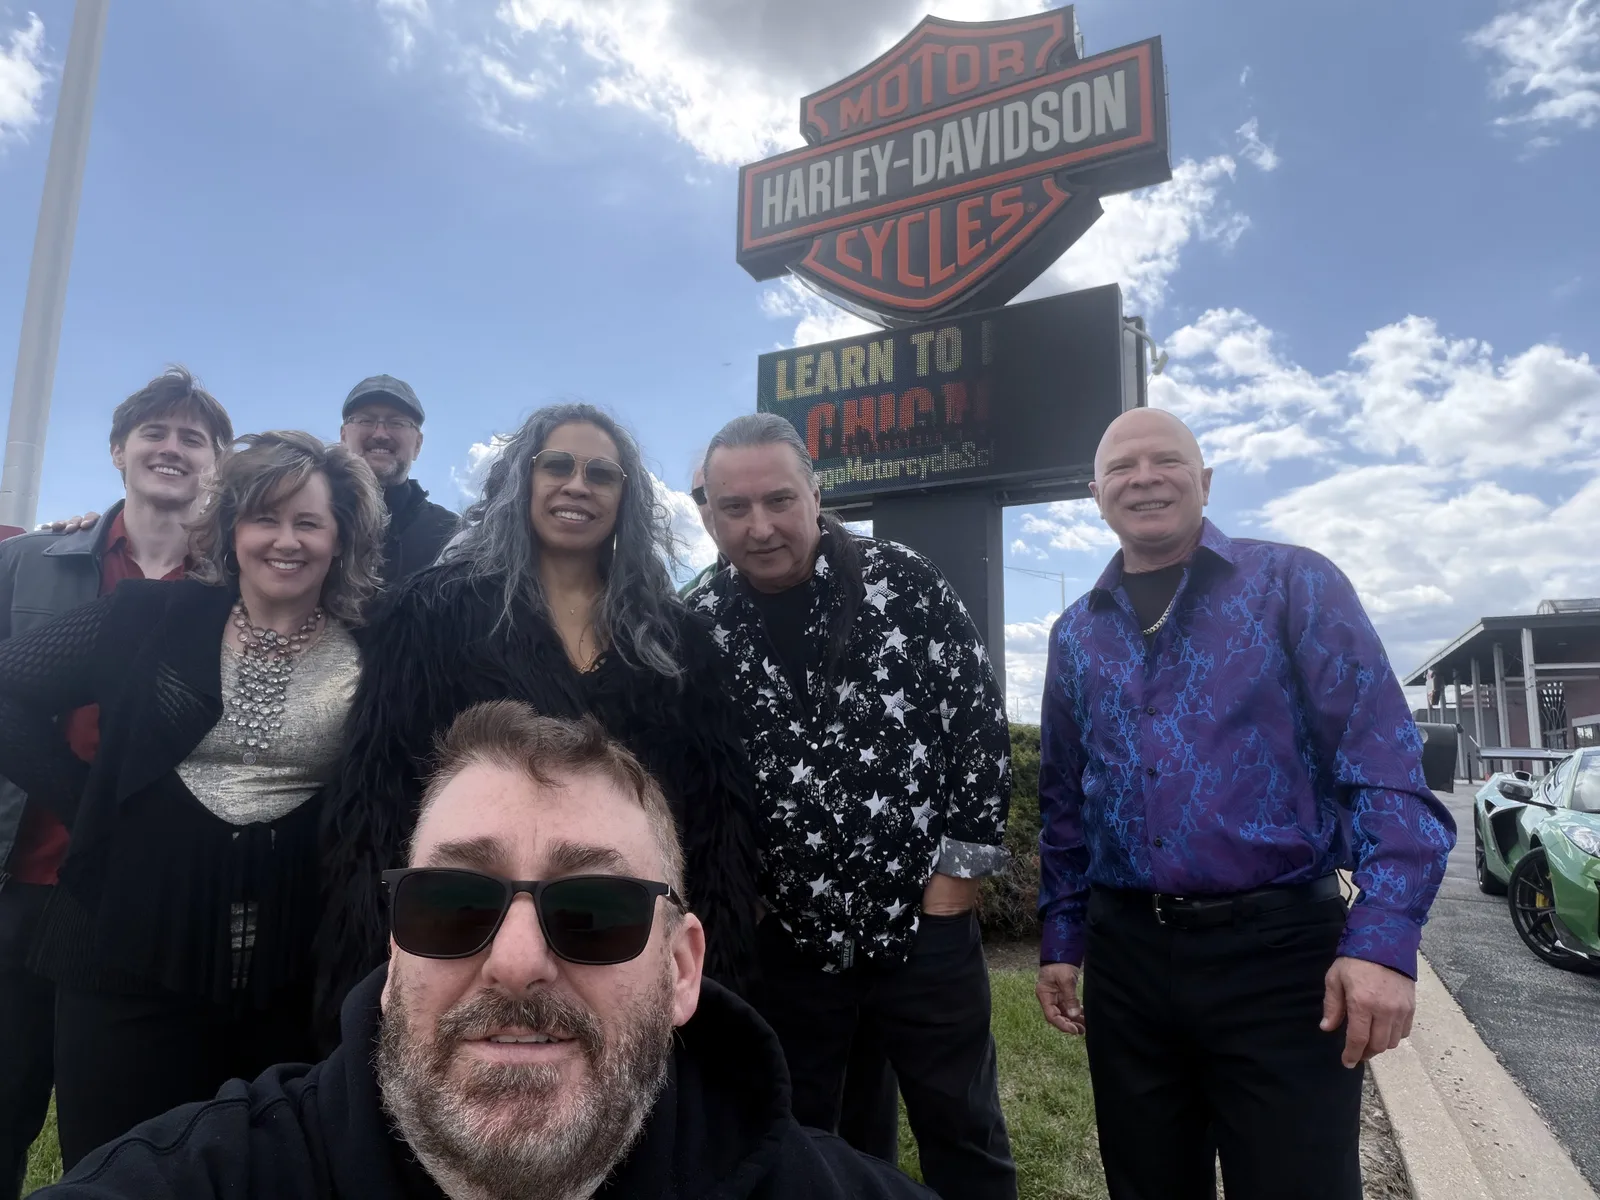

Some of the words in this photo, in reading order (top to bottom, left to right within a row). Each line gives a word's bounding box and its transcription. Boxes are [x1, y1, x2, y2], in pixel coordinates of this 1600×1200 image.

[840, 40, 1025, 131] MOTOR
[761, 69, 1128, 229] HARLEY-DAVIDSON
[835, 185, 1024, 289] CYCLES
[775, 338, 895, 402] LEARN
[909, 326, 963, 378] TO
